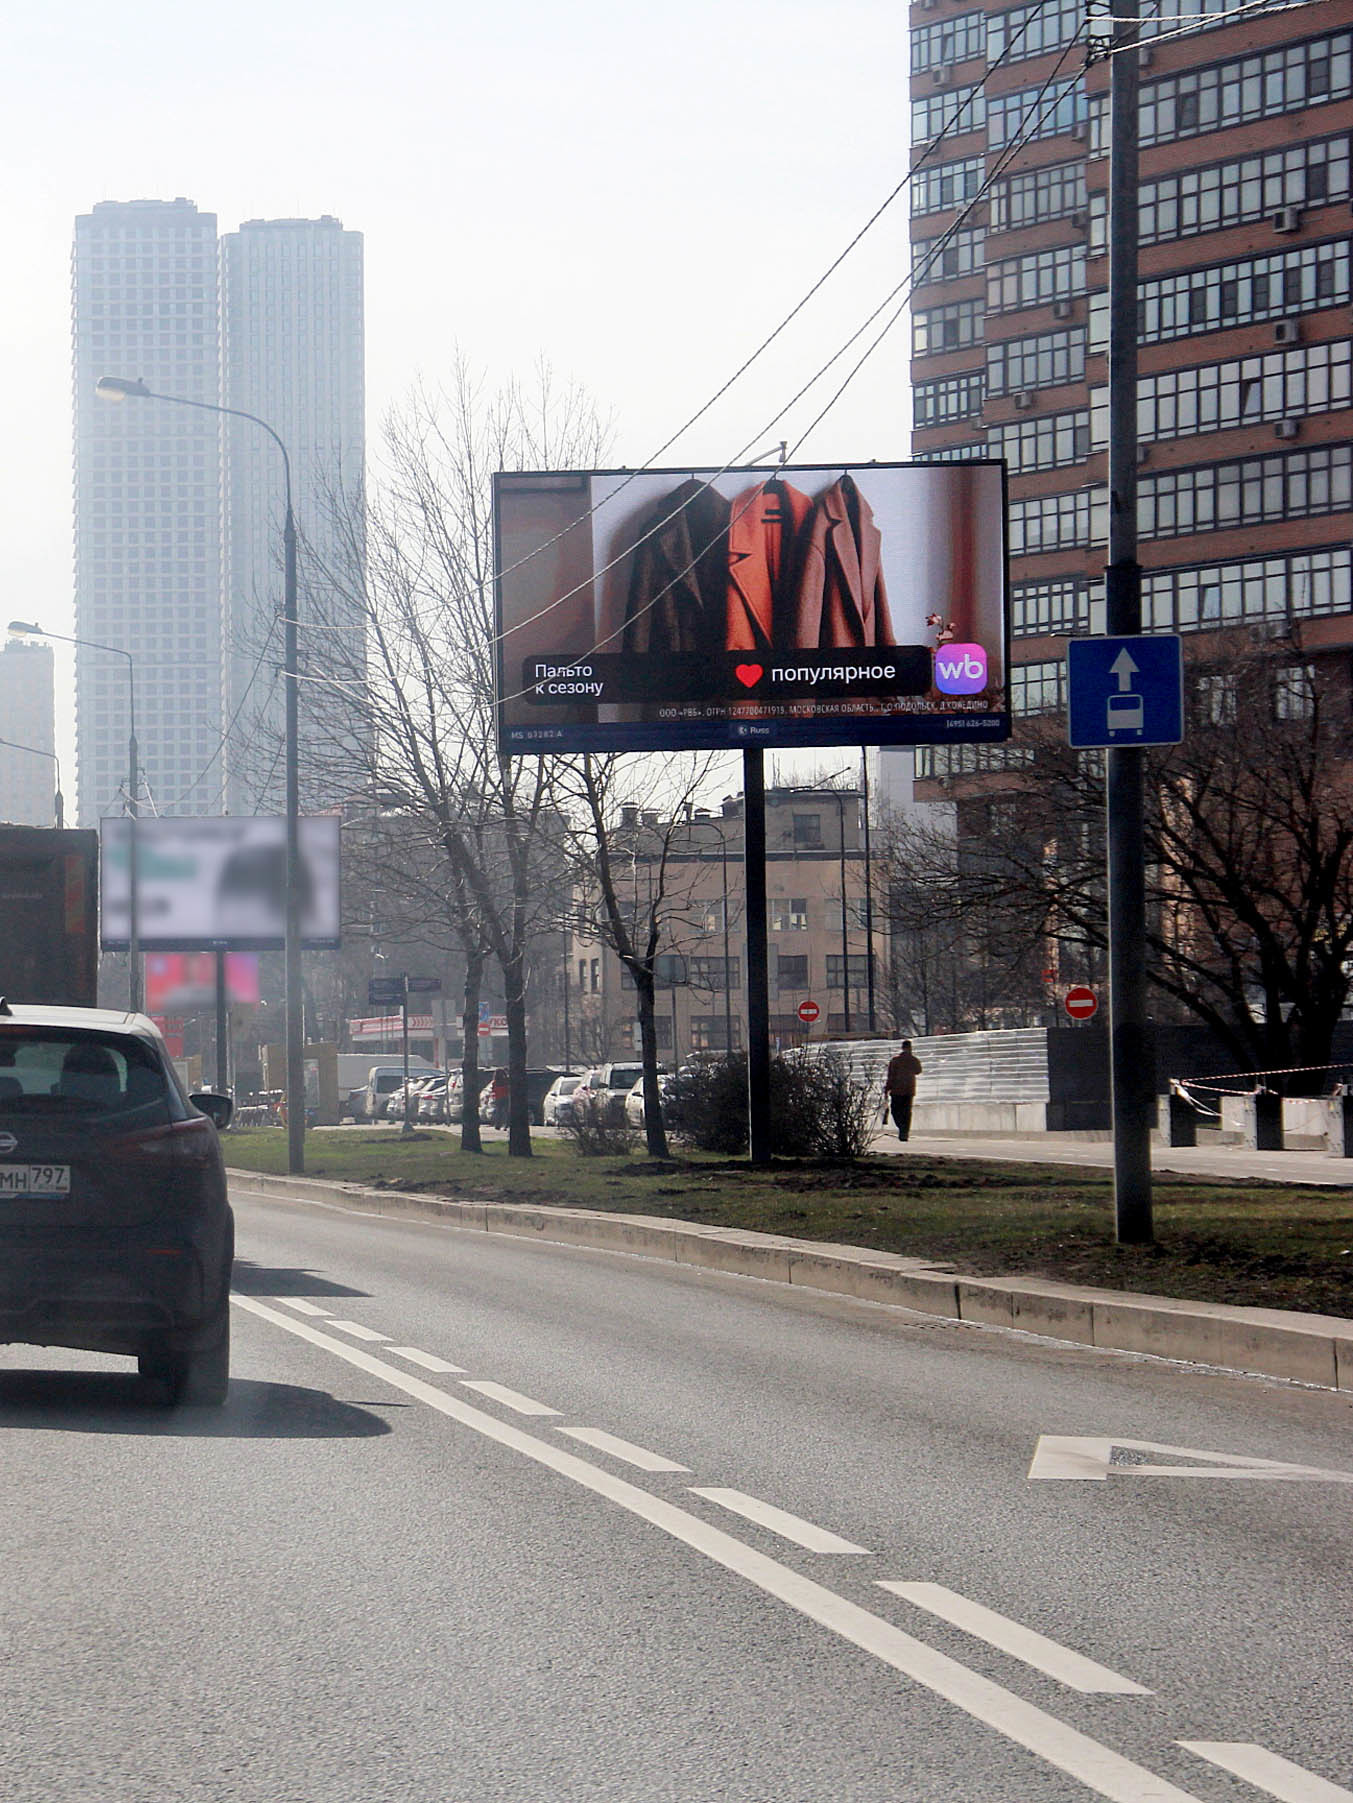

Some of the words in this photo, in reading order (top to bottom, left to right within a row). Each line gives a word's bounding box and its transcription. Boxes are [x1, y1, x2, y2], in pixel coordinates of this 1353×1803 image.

[535, 664, 593, 678] Пальто
[937, 653, 984, 679] wb
[771, 665, 896, 685] популярное
[535, 684, 545, 695] к
[548, 682, 604, 697] сезону
[659, 707, 677, 718] ООО
[789, 703, 840, 715] МОСКОВСКАЯ
[31, 1167, 65, 1184] 797
